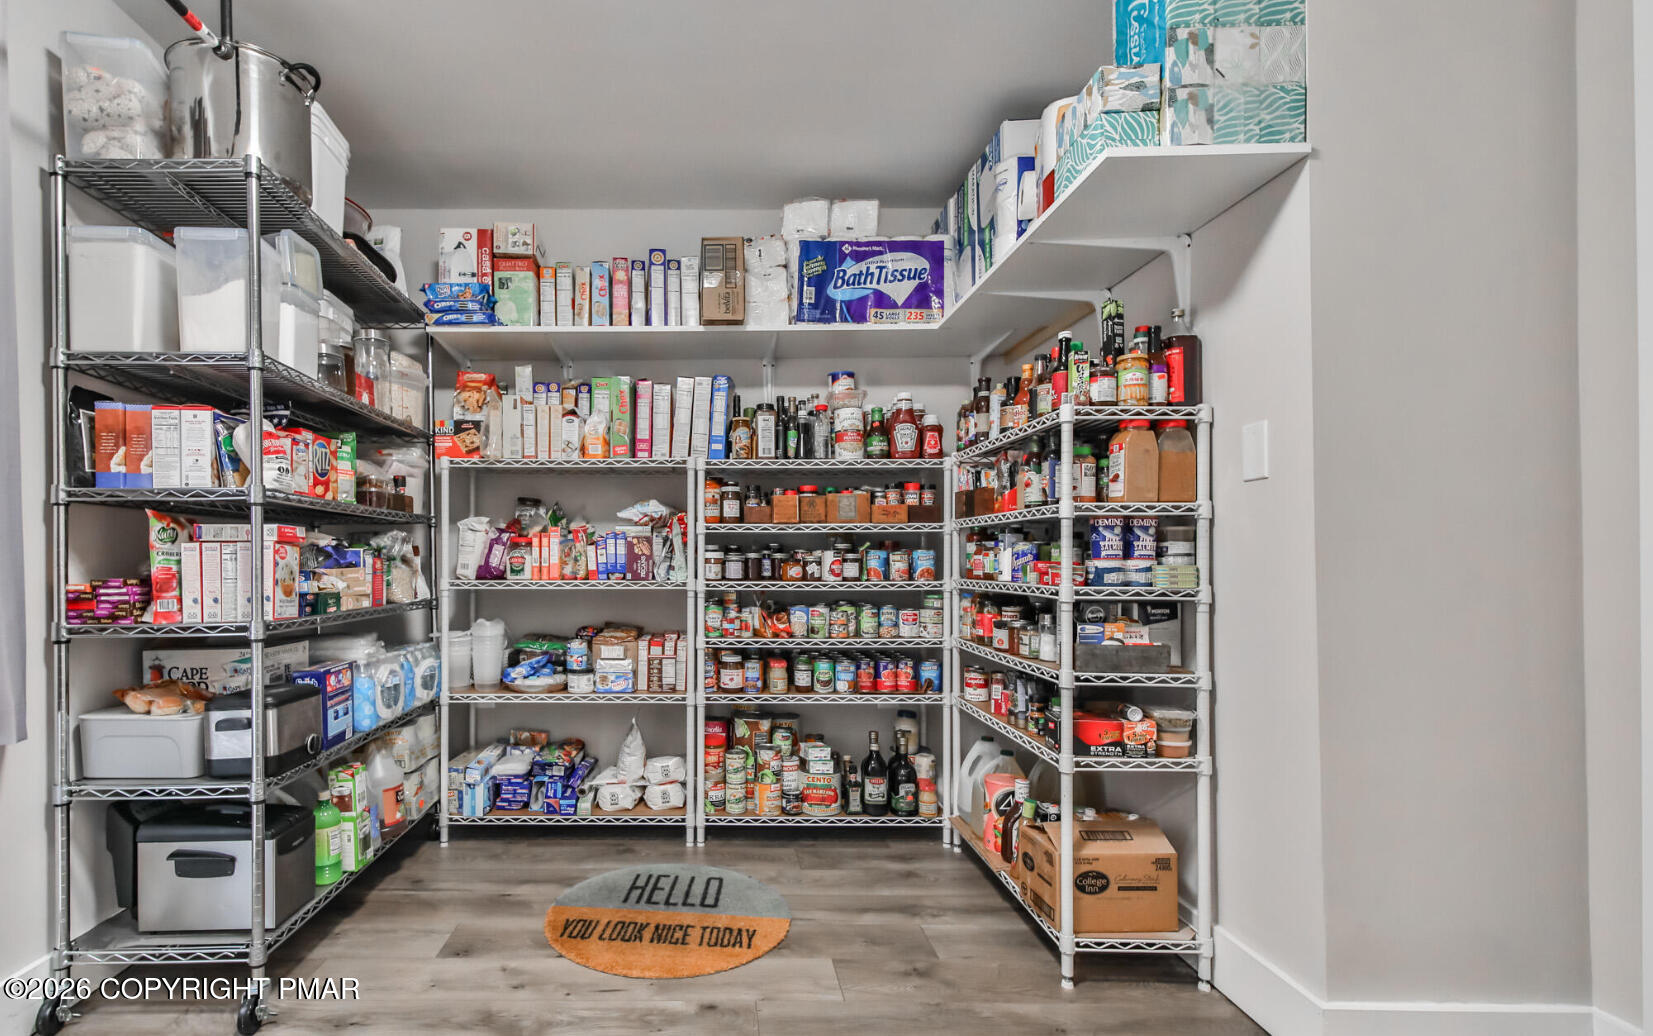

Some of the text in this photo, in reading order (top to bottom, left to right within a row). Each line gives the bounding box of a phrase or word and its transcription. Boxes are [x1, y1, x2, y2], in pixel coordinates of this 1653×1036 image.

[872, 311, 884, 320] 45
[906, 311, 924, 320] 235
[436, 426, 454, 434] KIND
[313, 449, 331, 472] RITZ
[1094, 518, 1124, 526] DEMING
[1129, 518, 1158, 526] DEMING
[167, 666, 209, 680] CAPE
[806, 776, 832, 784] CENTO
[1077, 876, 1107, 887] College
[622, 873, 723, 908] HELLO
[1085, 885, 1099, 893] Inn
[559, 918, 757, 949] YOU LOOK NICE TODAY
